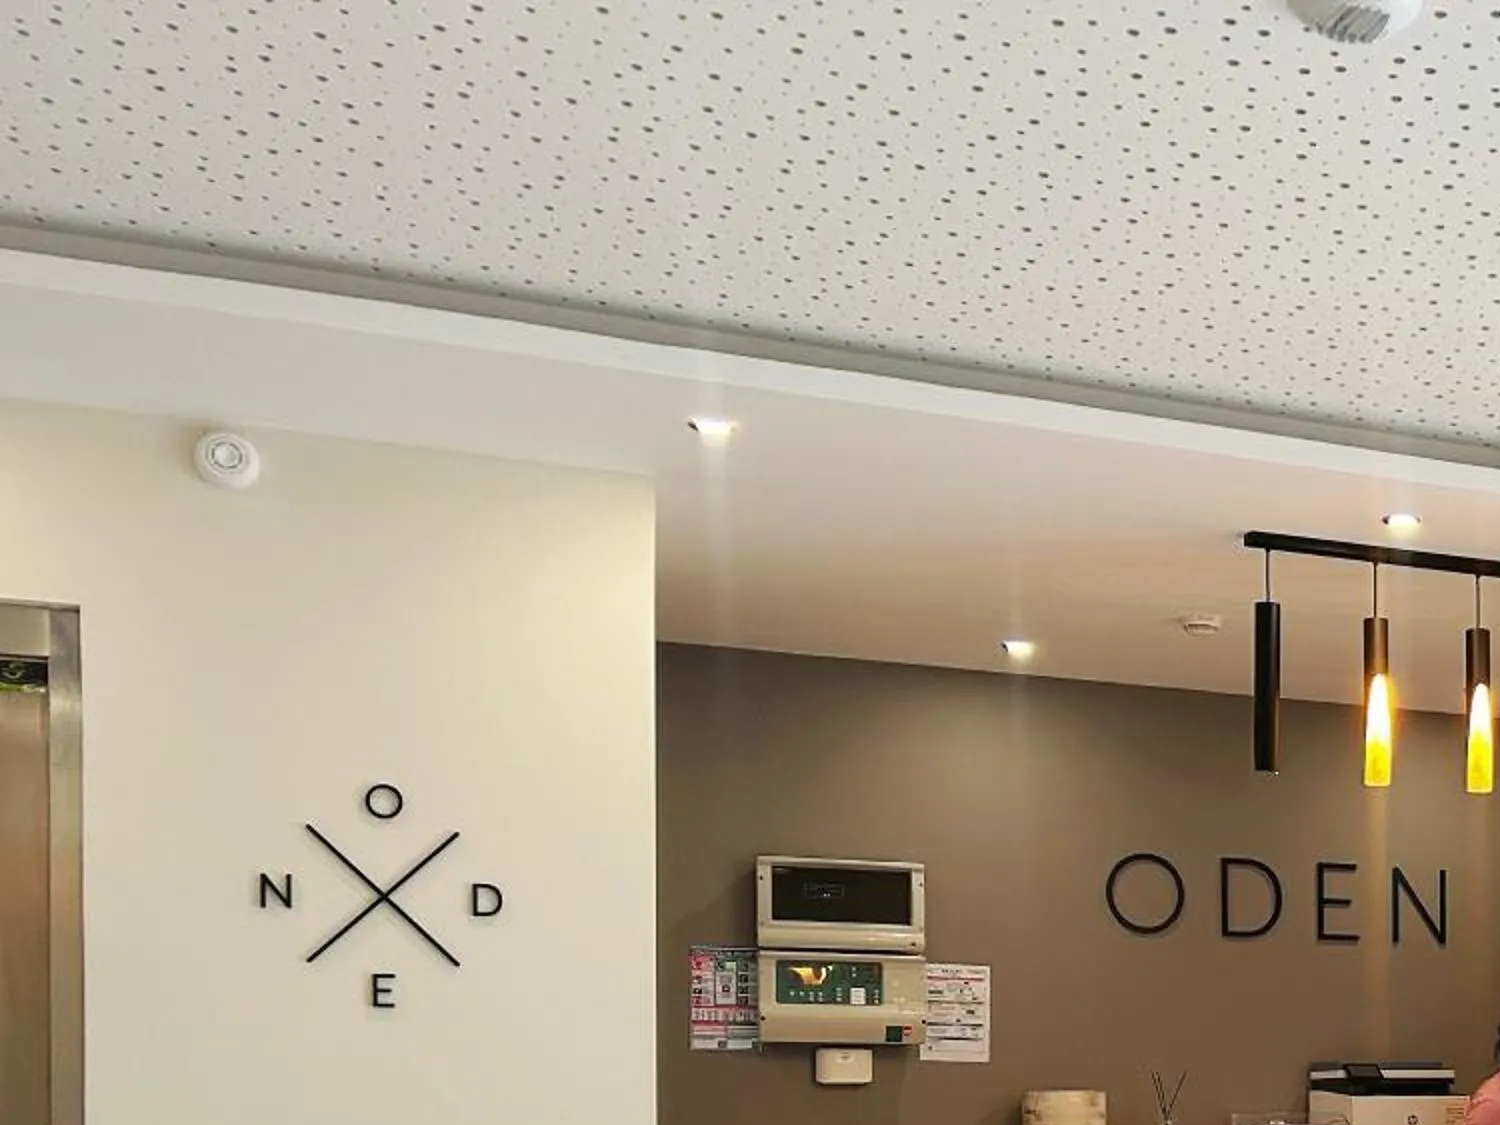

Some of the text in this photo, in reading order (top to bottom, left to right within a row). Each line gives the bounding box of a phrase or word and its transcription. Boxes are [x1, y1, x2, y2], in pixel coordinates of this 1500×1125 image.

[365, 784, 403, 818] O
[260, 873, 292, 908] N
[471, 883, 503, 917] D
[1106, 853, 1446, 945] ODEN
[371, 973, 396, 1008] E
